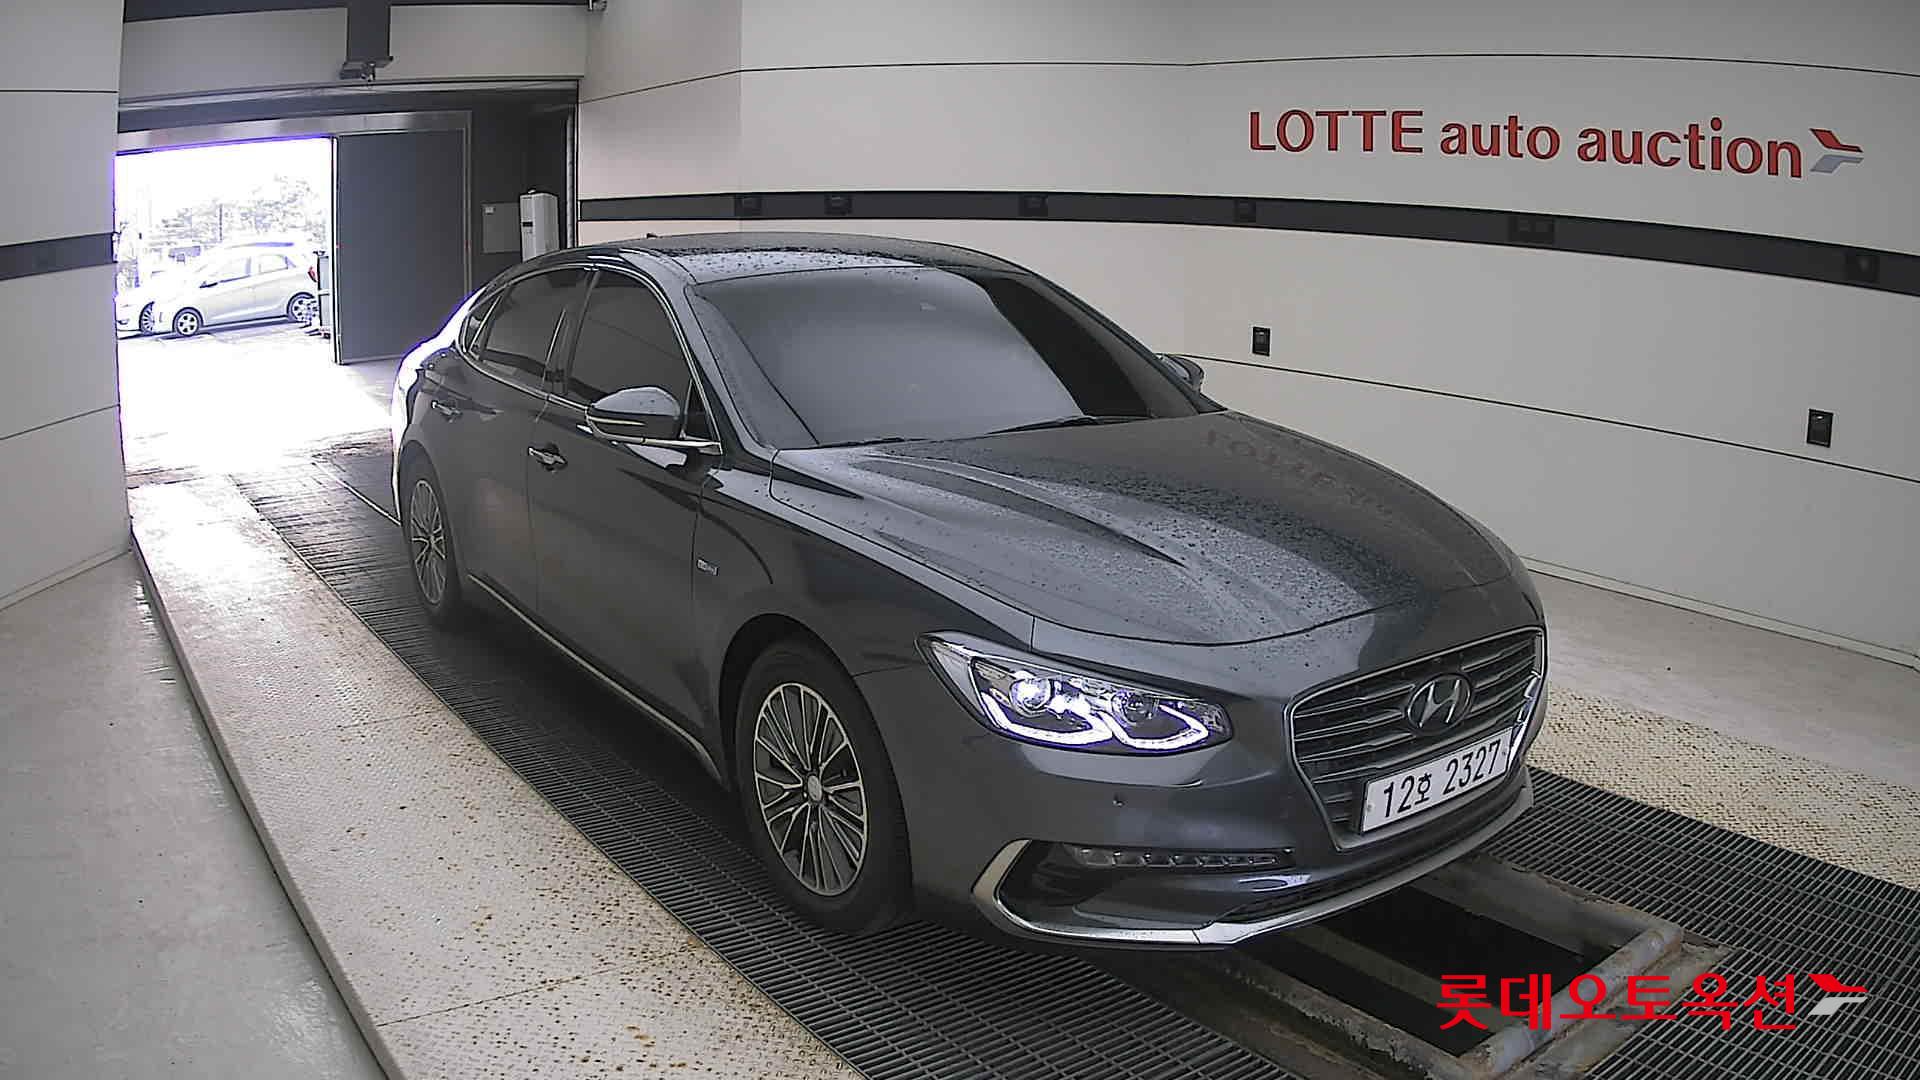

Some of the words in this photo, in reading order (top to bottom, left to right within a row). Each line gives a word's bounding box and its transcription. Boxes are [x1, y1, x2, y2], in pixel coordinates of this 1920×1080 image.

[1249, 110, 1424, 154] LOTTE
[1440, 116, 1561, 161] auto
[1577, 117, 1803, 179] auction
[1443, 739, 1501, 796] 2327
